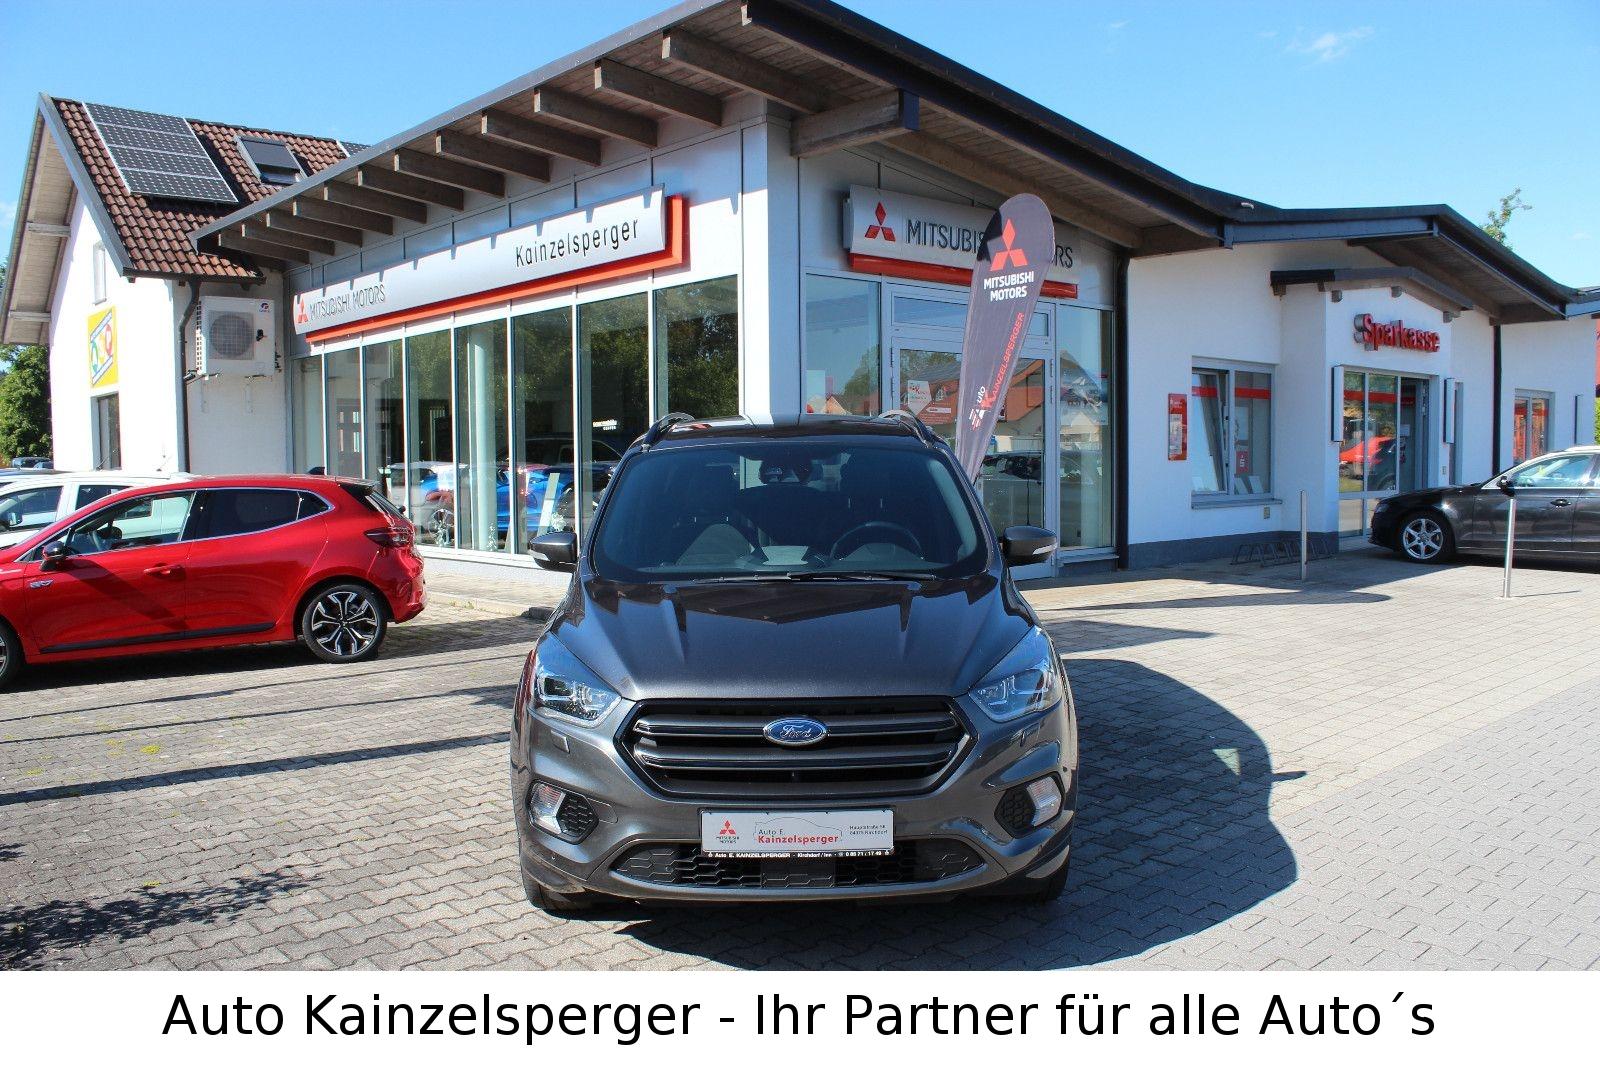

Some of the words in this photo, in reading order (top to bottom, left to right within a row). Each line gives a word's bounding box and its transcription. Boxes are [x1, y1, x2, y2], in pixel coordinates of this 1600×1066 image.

[515, 217, 640, 268] Kainzelsperger
[906, 219, 986, 254] MITSUBIS
[983, 270, 1035, 290] MITSUBISHI
[308, 293, 352, 321] MITSUBISHI
[352, 284, 386, 309] MOTORS
[989, 286, 1028, 303] MOTORS
[1354, 313, 1440, 352] Sparkasse
[779, 724, 812, 738] Ford
[758, 834, 839, 845] Kainzelsperger
